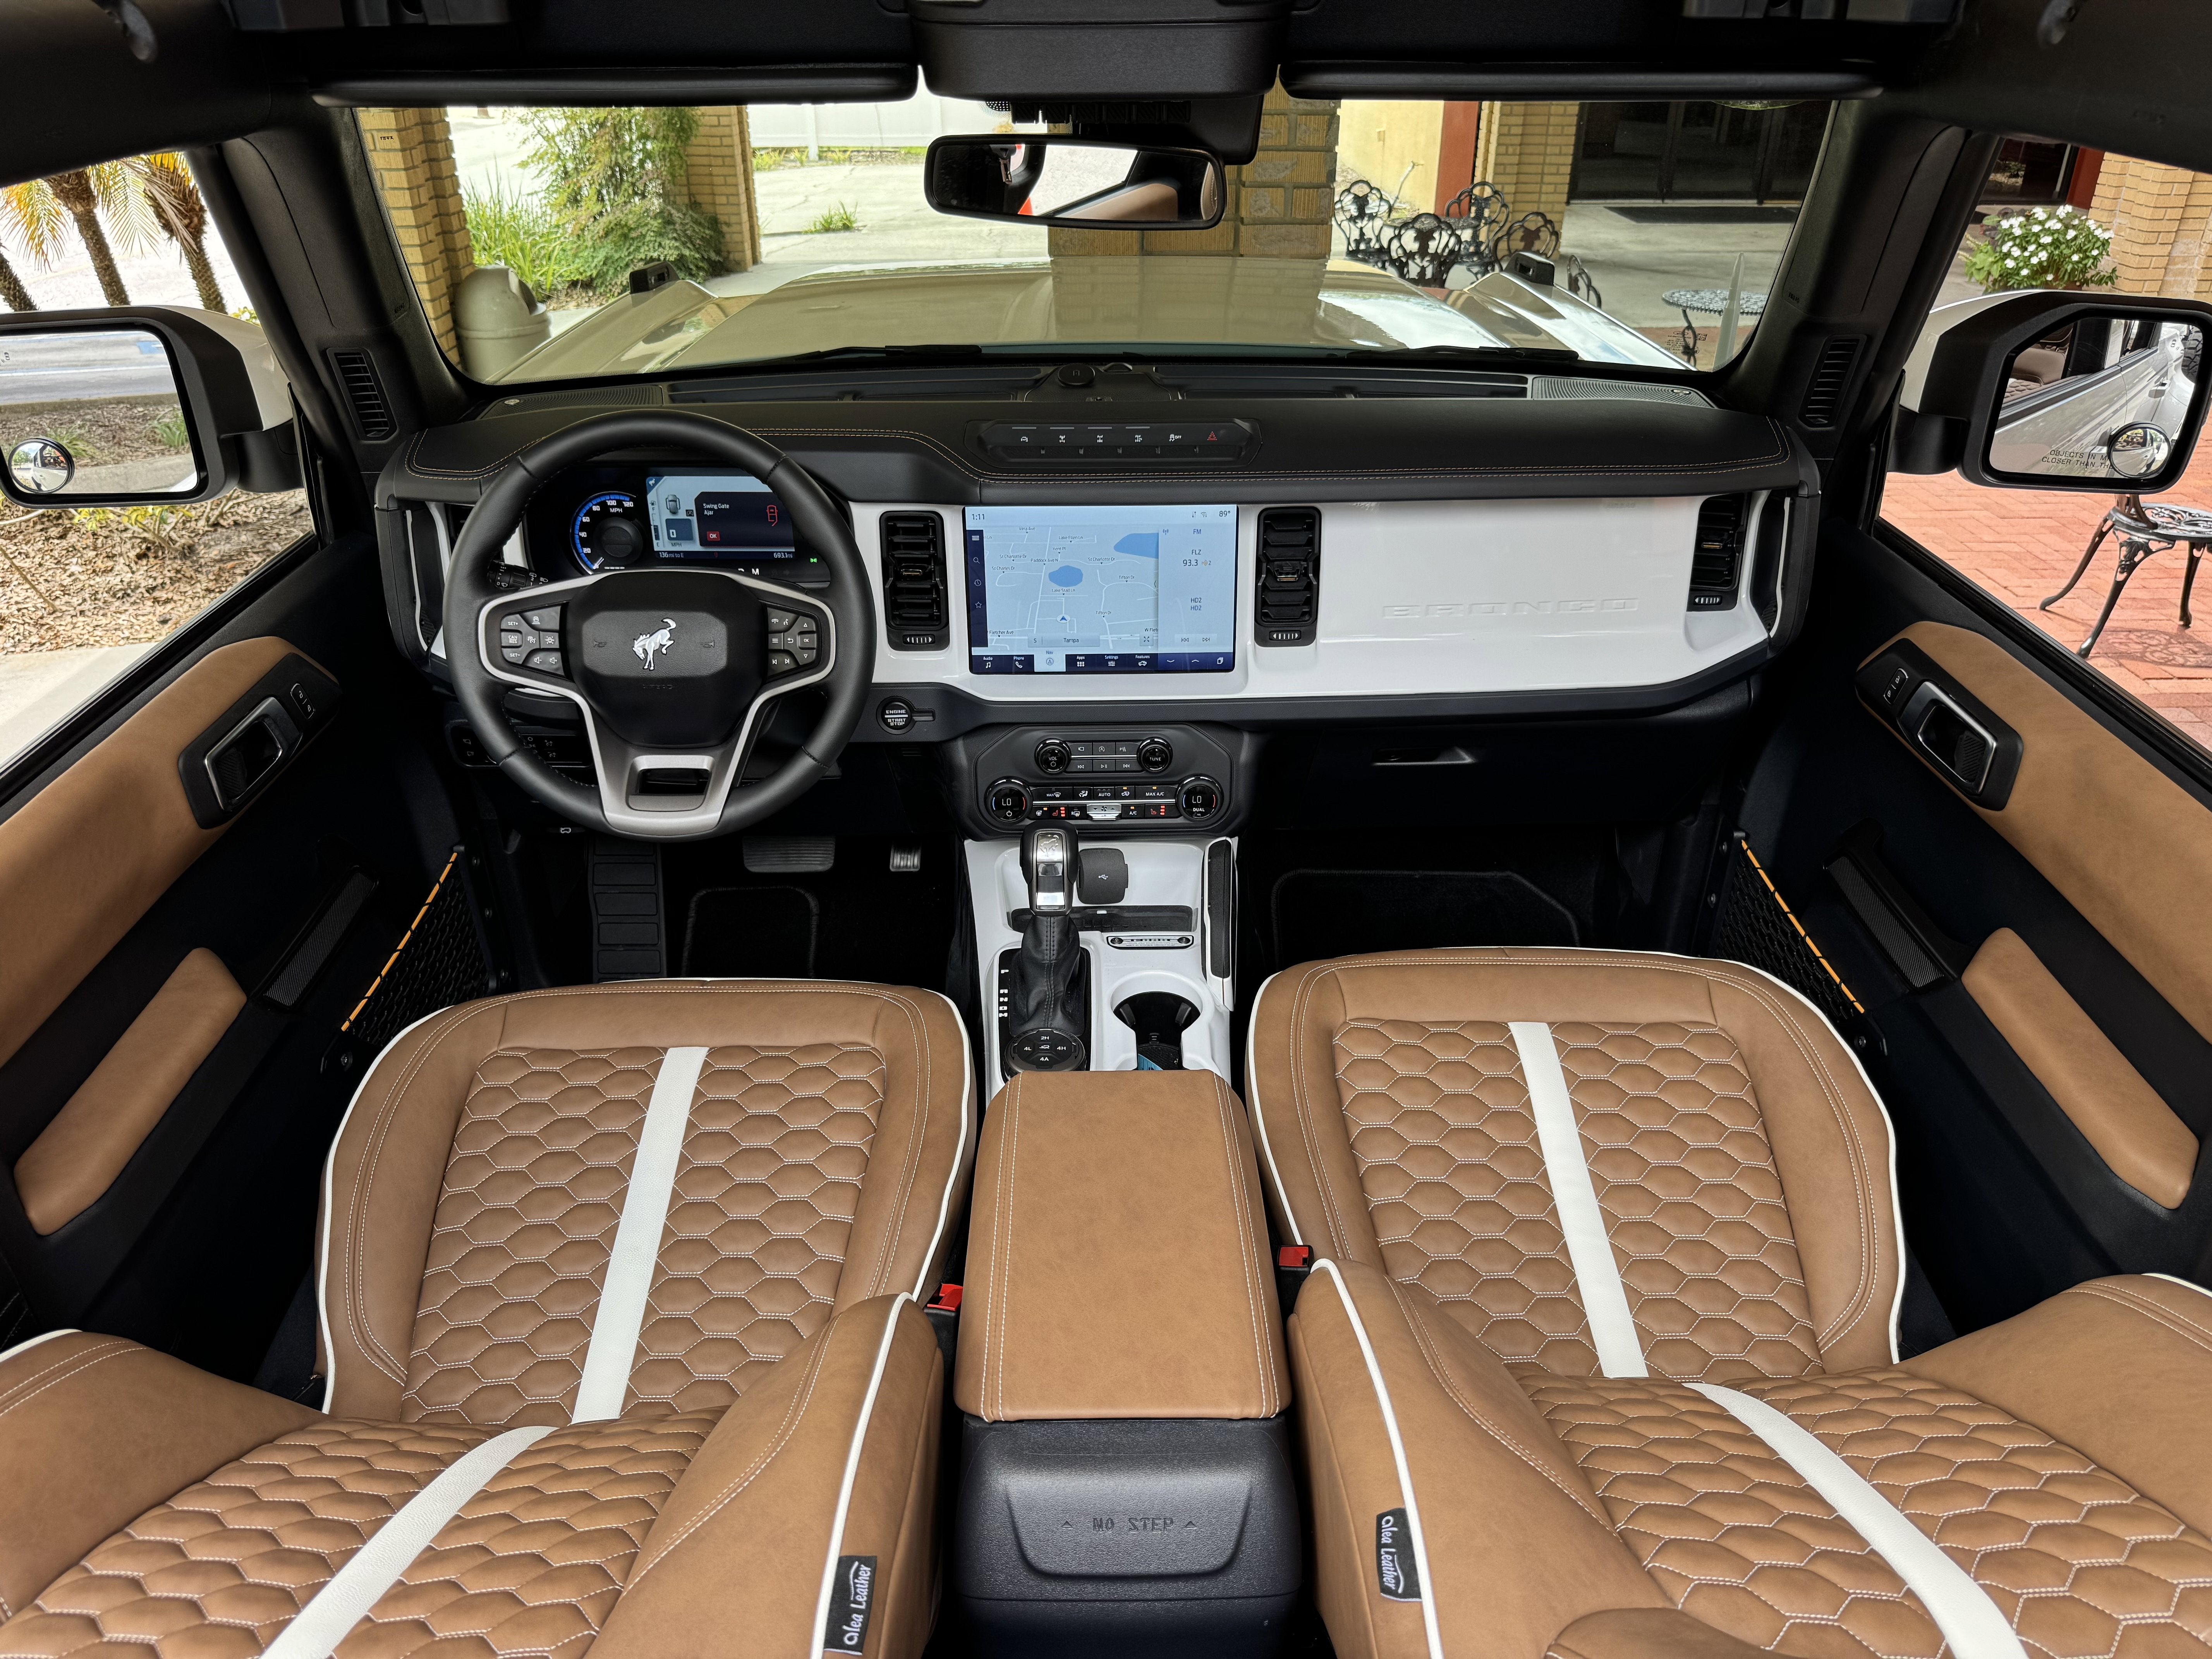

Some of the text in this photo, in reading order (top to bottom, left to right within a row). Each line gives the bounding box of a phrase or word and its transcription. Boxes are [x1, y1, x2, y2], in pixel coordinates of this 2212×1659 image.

[2042, 457, 2071, 465] CLOSER
[2050, 450, 2084, 459] OBJECTS
[670, 529, 677, 538] 0
[1382, 598, 1638, 619] BRONCO
[1093, 1517, 1174, 1532] NO STEP
[1381, 1516, 1398, 1590] Olea Leather
[842, 1564, 871, 1645] Olea Leather
